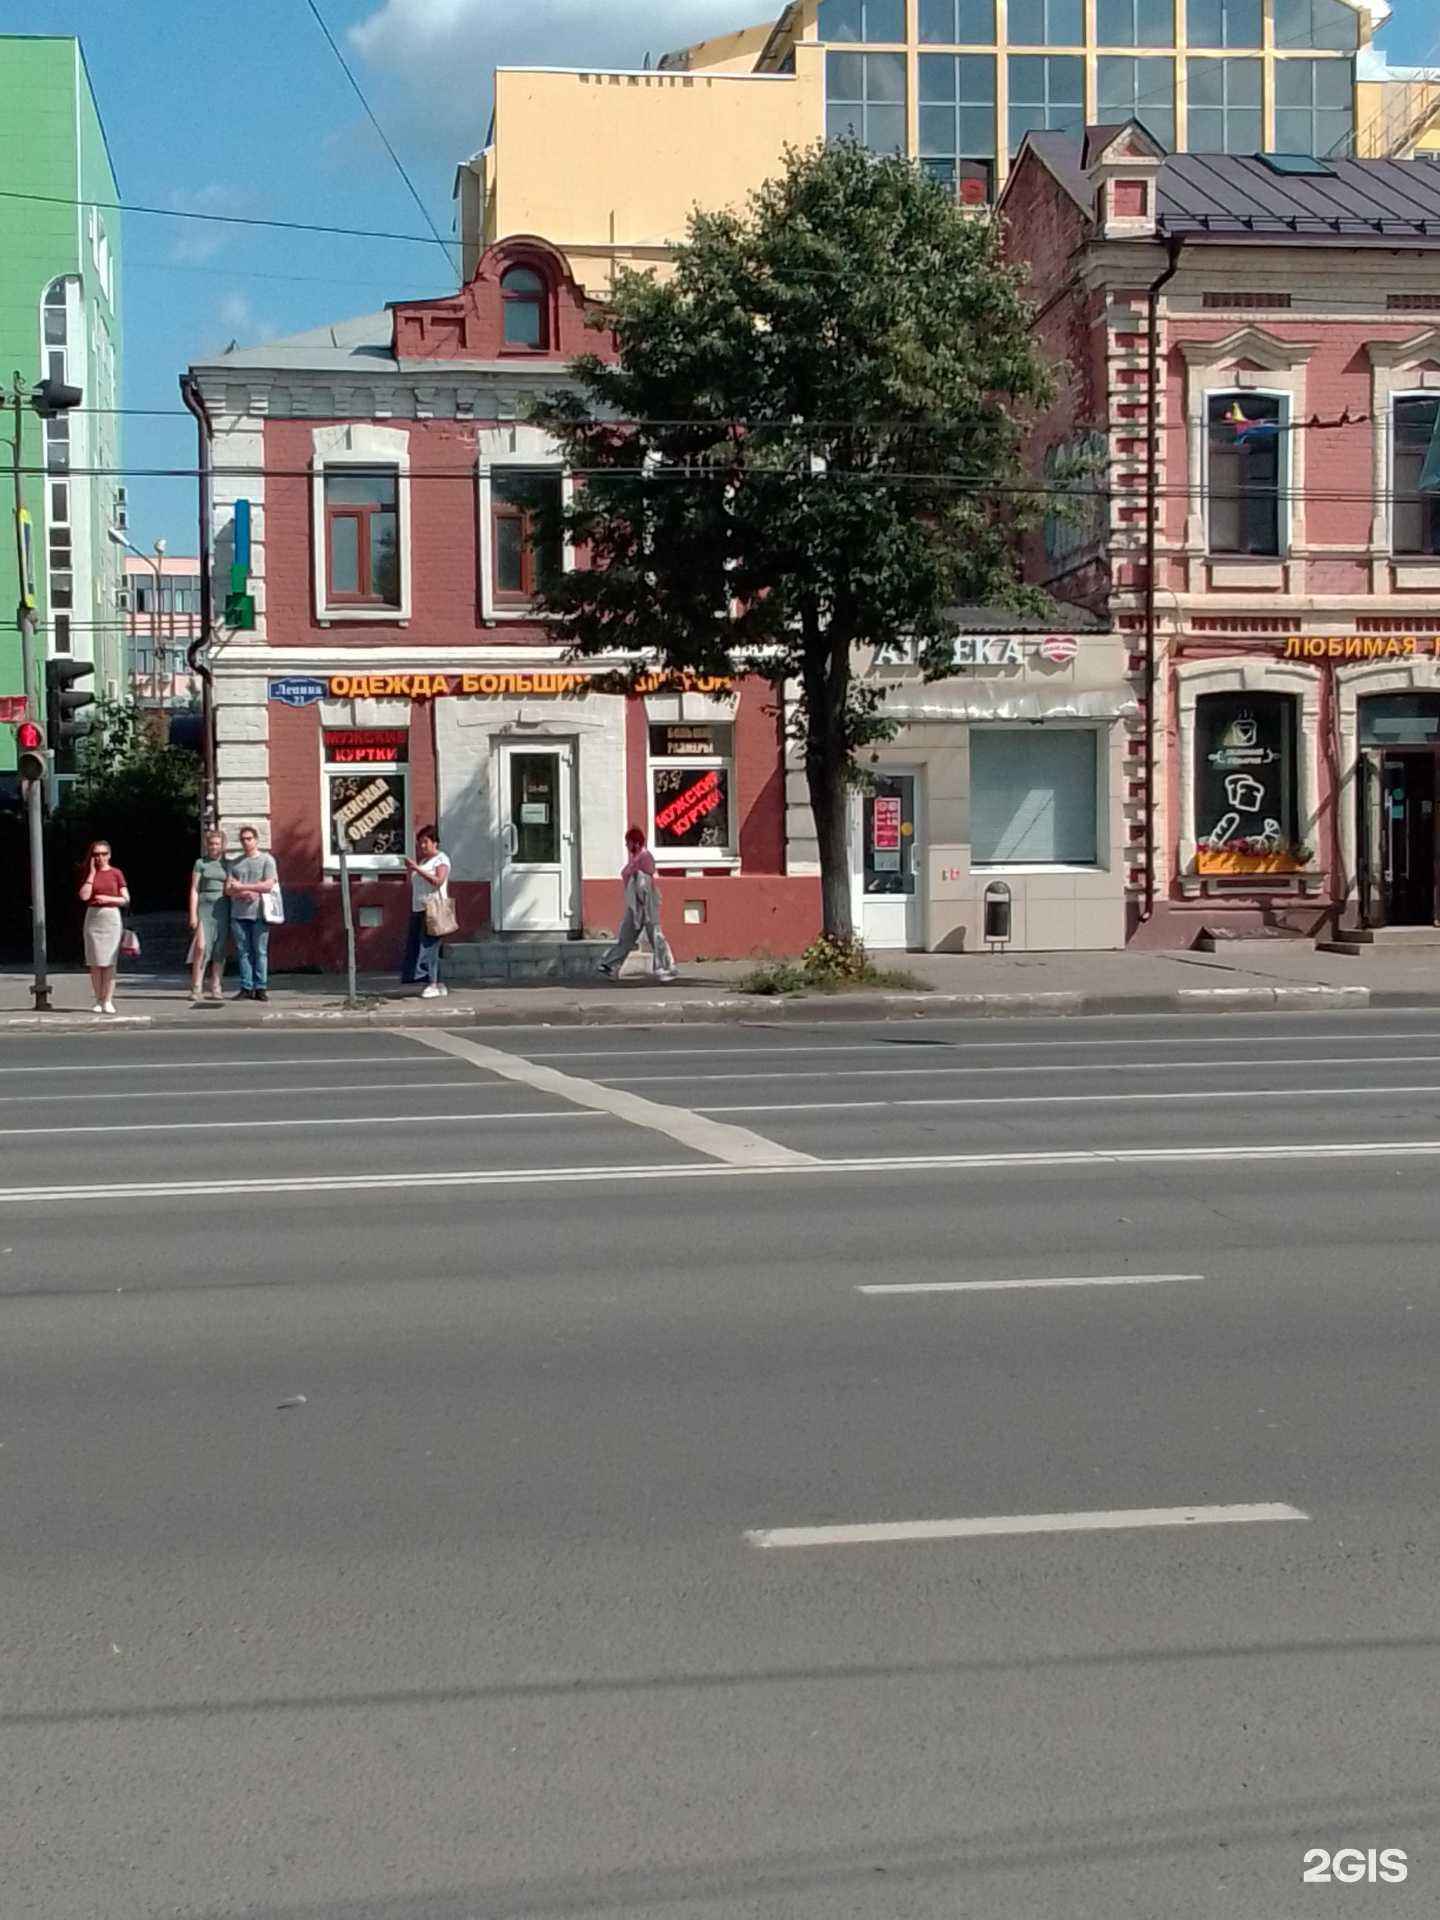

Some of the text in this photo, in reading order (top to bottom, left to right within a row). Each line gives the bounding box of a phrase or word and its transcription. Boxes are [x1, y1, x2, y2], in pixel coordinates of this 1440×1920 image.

[1284, 637, 1417, 658] ЛЮБИМАЯ
[331, 675, 449, 697] ОДЕЖДА
[335, 748, 398, 761] КУРТКИ
[332, 778, 390, 824] ЖЕНСКАЯ
[347, 795, 401, 840] ОДЕЖДА
[672, 788, 724, 835] КУРТКИ
